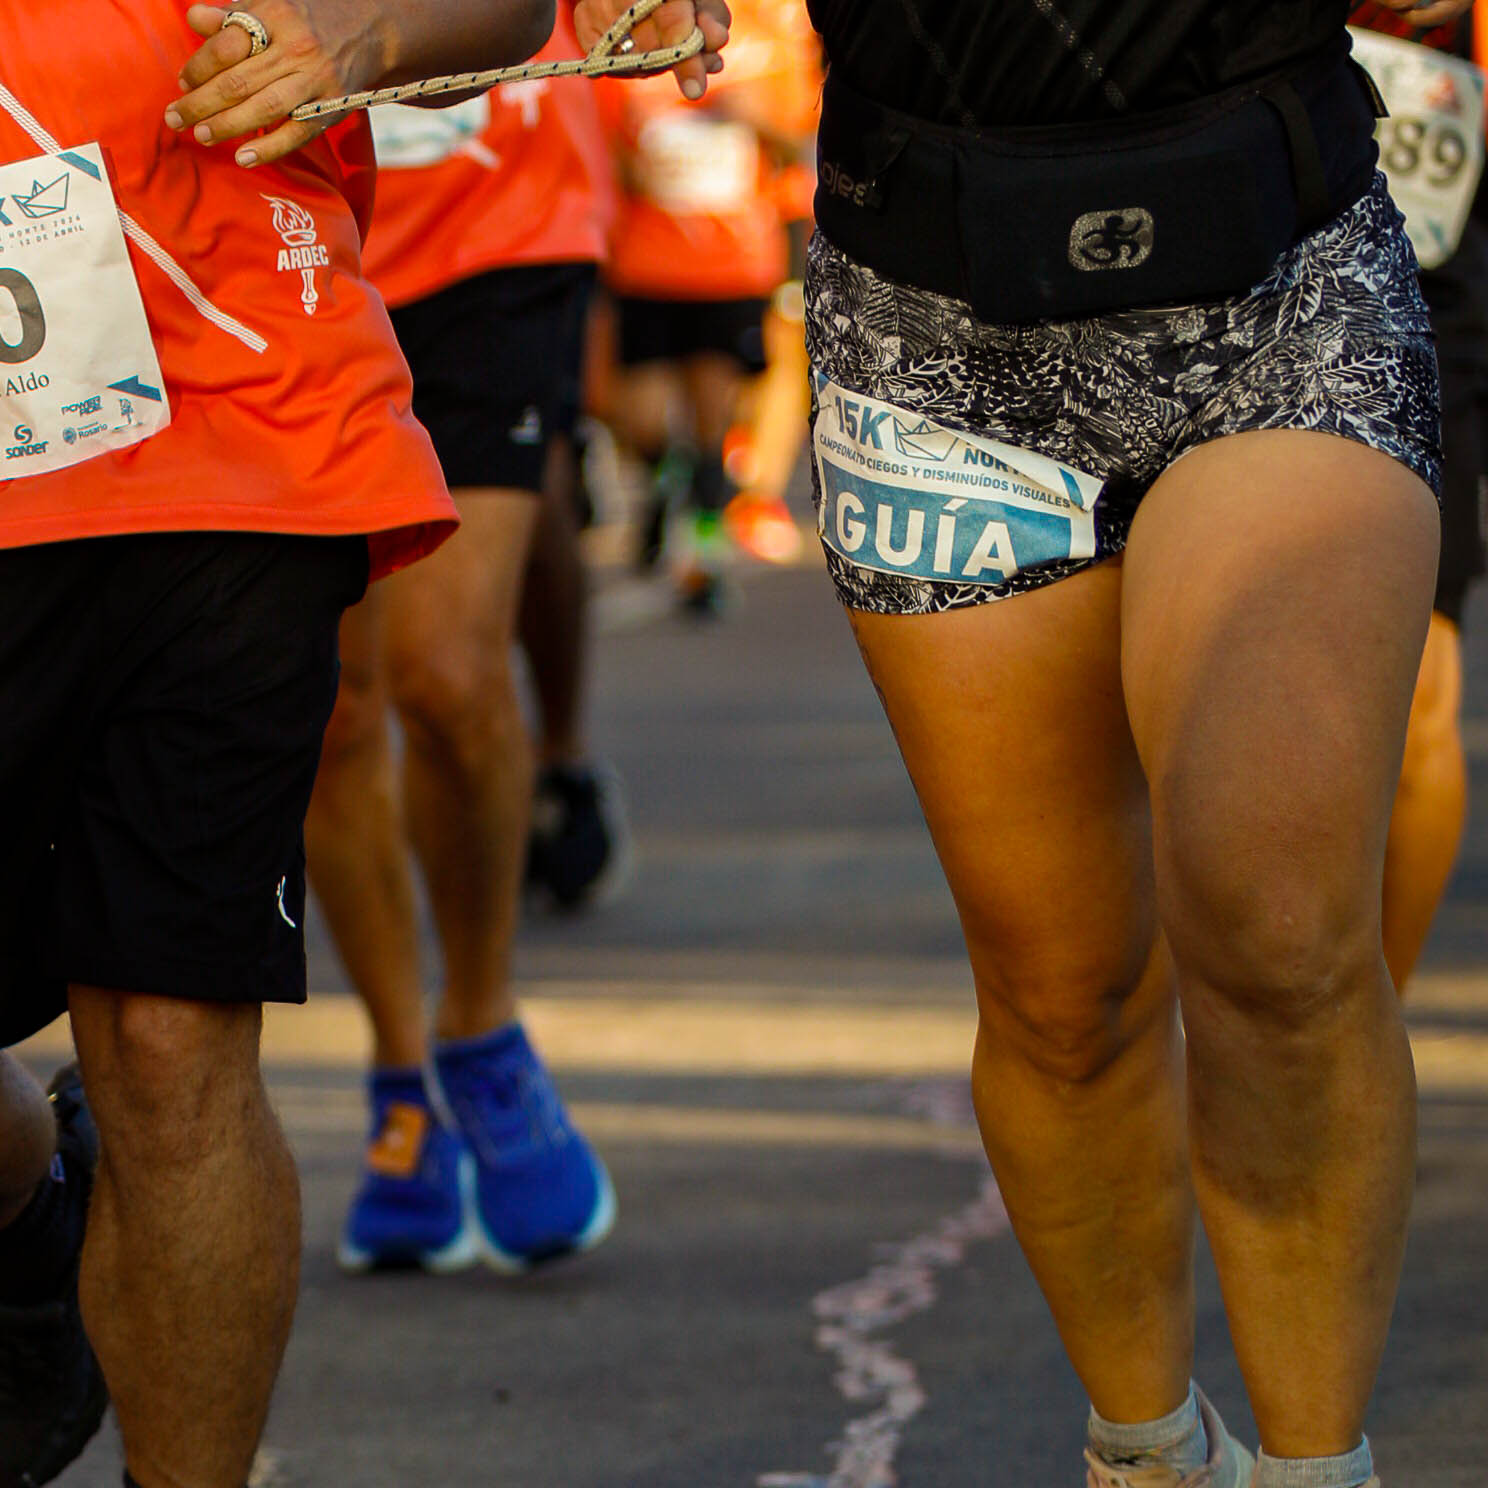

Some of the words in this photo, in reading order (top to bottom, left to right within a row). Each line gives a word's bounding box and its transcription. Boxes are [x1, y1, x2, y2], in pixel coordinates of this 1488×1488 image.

[9, 224, 46, 238] NORTE
[36, 234, 49, 243] DE
[53, 225, 85, 238] ABRIL
[277, 244, 329, 272] ARDEC
[6, 372, 50, 397] Aldo
[78, 423, 108, 439] Rosario
[834, 395, 891, 451] 15K
[819, 433, 866, 466] CAMPEONATO
[866, 457, 908, 476] CIEGOS
[912, 466, 919, 477] Y
[923, 469, 1009, 491] DISMINUÍDOS
[1012, 482, 1070, 508] VISUALES
[836, 498, 1019, 578] GUÍA
